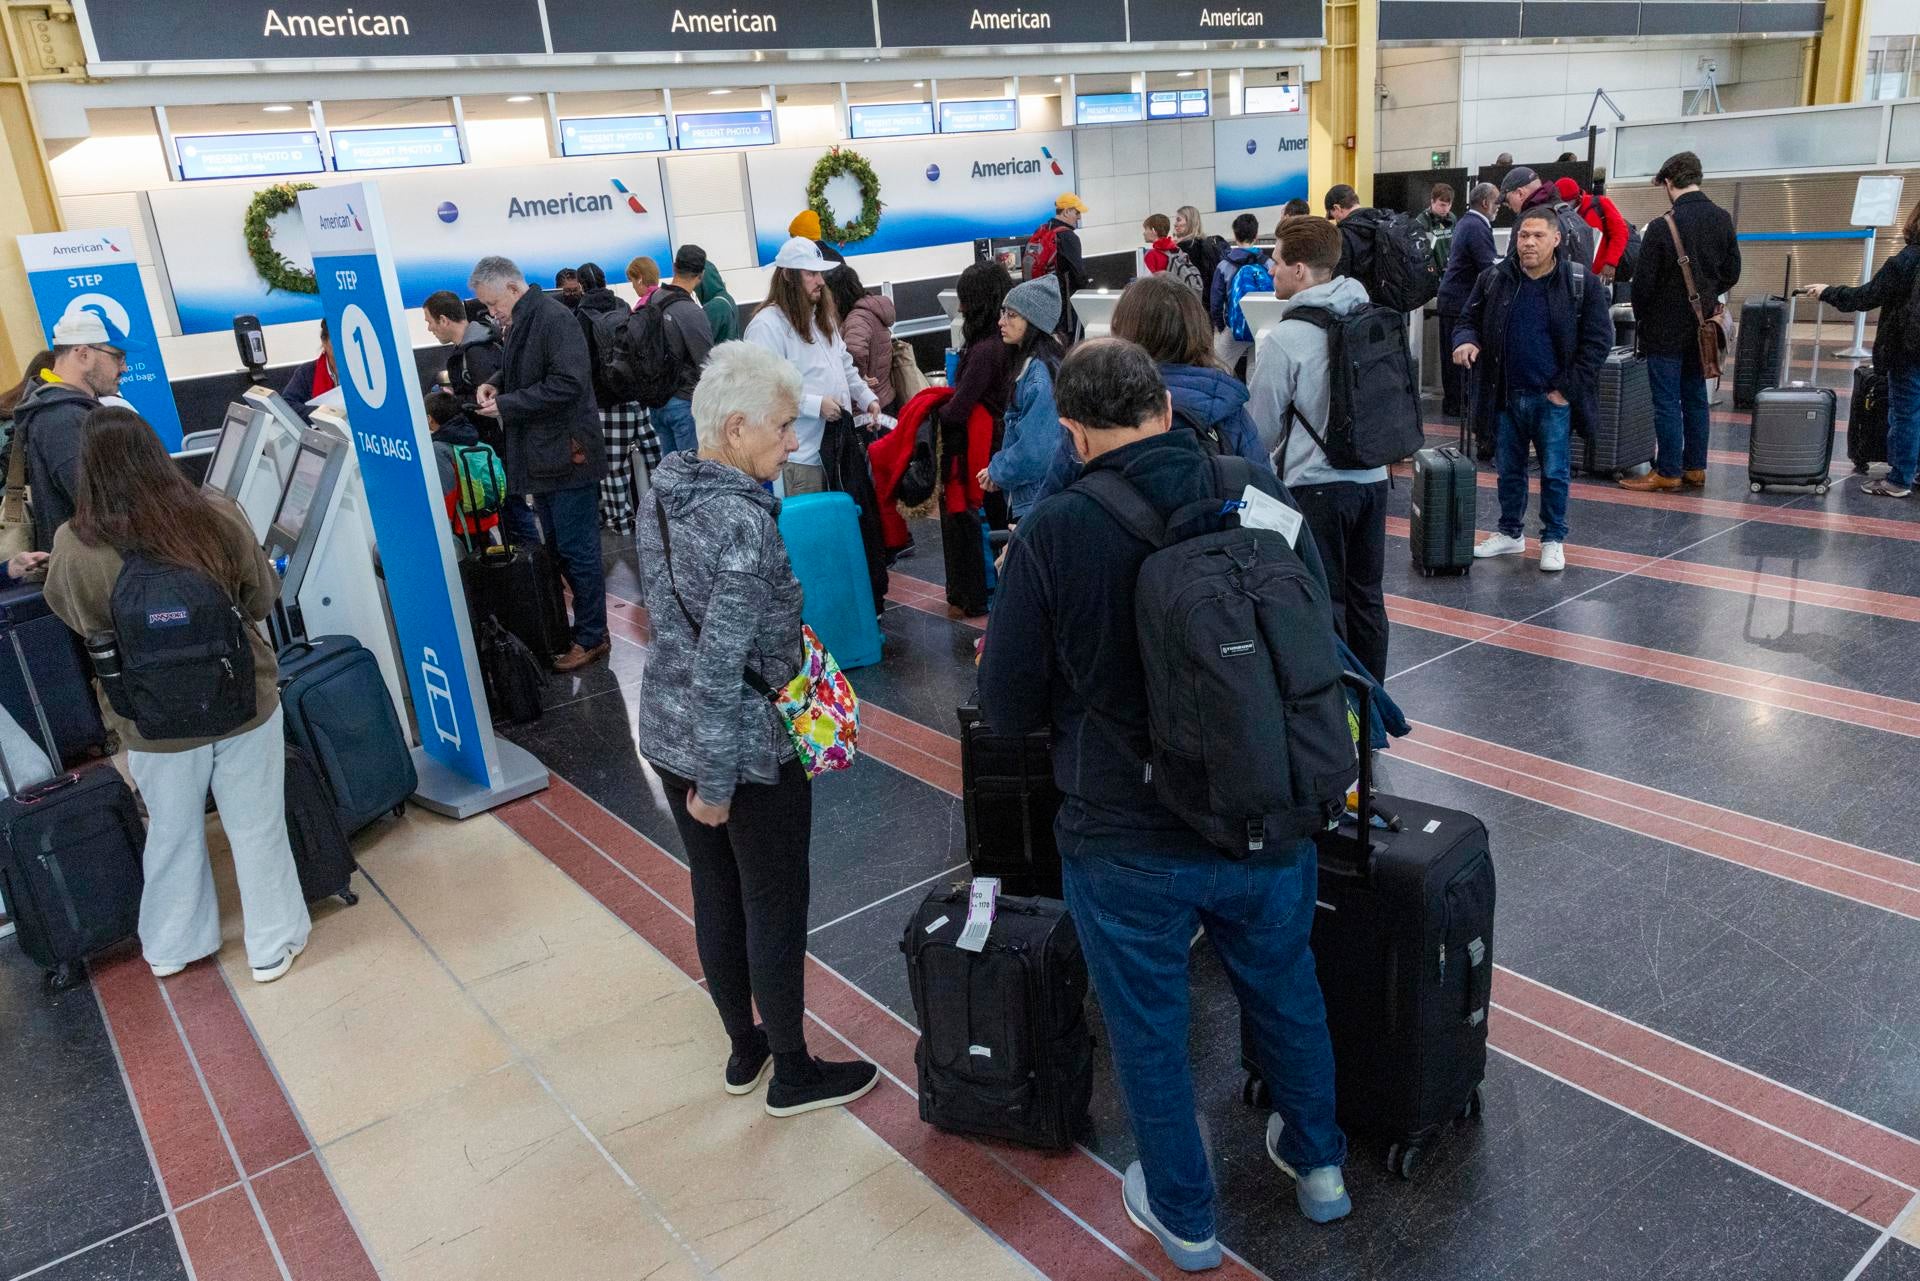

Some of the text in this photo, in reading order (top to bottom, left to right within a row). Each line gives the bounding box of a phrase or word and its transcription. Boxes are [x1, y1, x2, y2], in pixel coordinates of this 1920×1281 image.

[263, 8, 410, 37] American
[671, 8, 777, 33] American
[970, 8, 1051, 30] American
[1200, 7, 1264, 27] American
[726, 127, 752, 136] PHOTO
[1278, 135, 1309, 152] Amer
[971, 157, 1041, 178] American
[508, 192, 613, 218] American
[319, 214, 351, 230] American
[52, 243, 104, 255] American
[67, 274, 103, 288] STEP
[335, 271, 357, 290] STEP
[135, 362, 146, 371] ID
[352, 326, 374, 391] 1
[135, 373, 156, 382] bags
[358, 431, 412, 461] TAG BAGS
